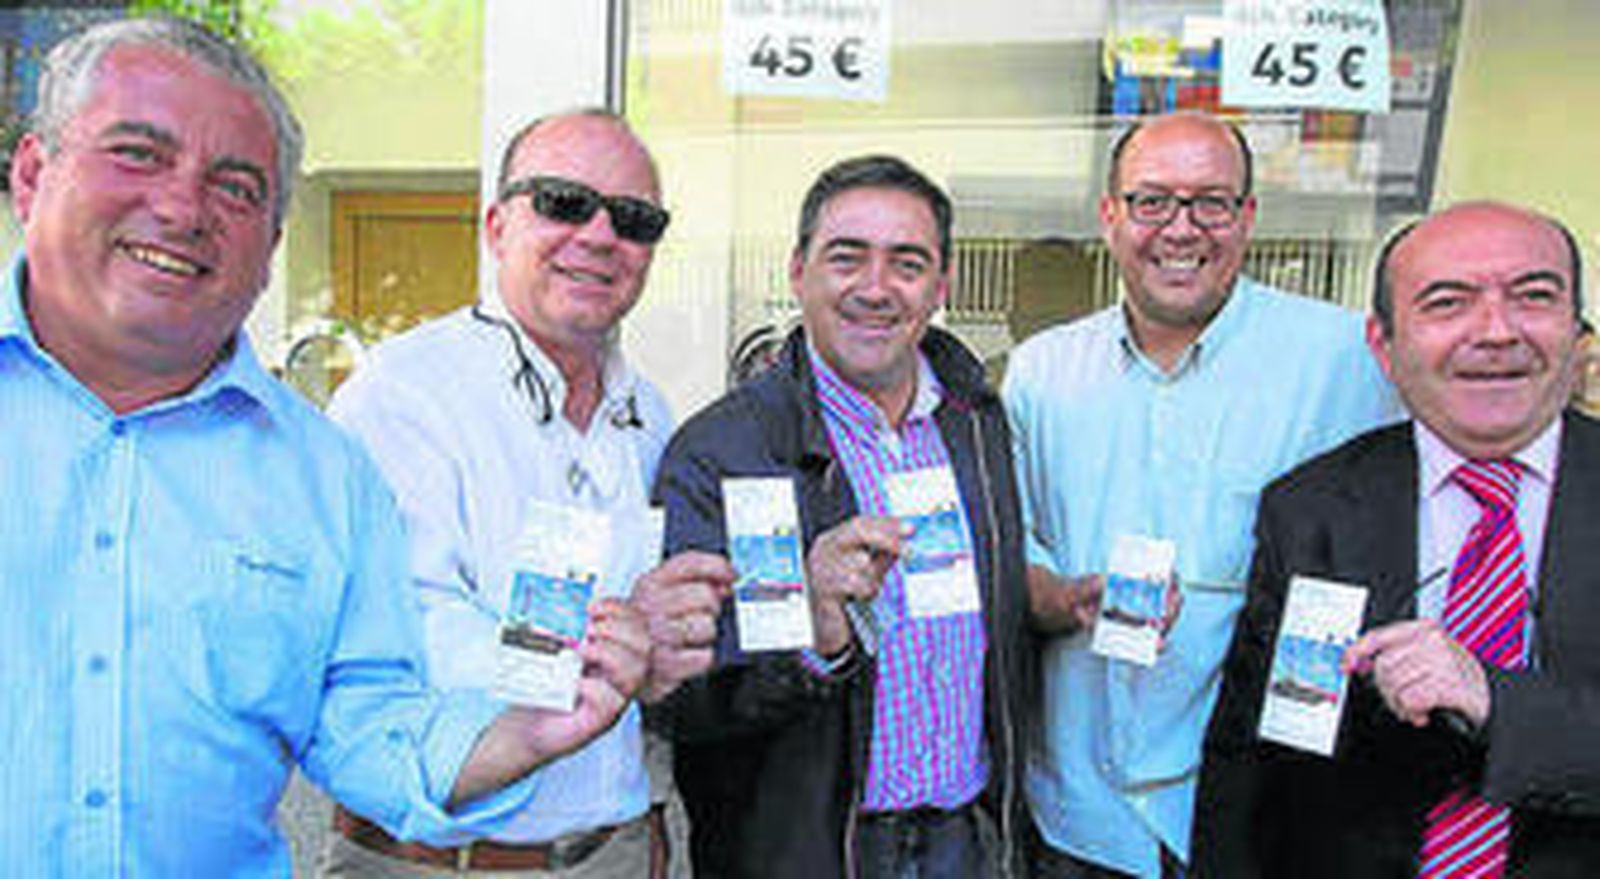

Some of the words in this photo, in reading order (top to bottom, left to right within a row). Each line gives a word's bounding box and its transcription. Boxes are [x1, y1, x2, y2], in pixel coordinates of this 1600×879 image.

[750, 35, 814, 77] 45
[831, 37, 863, 81] €
[1251, 42, 1319, 87] 45
[1338, 45, 1367, 90] €
